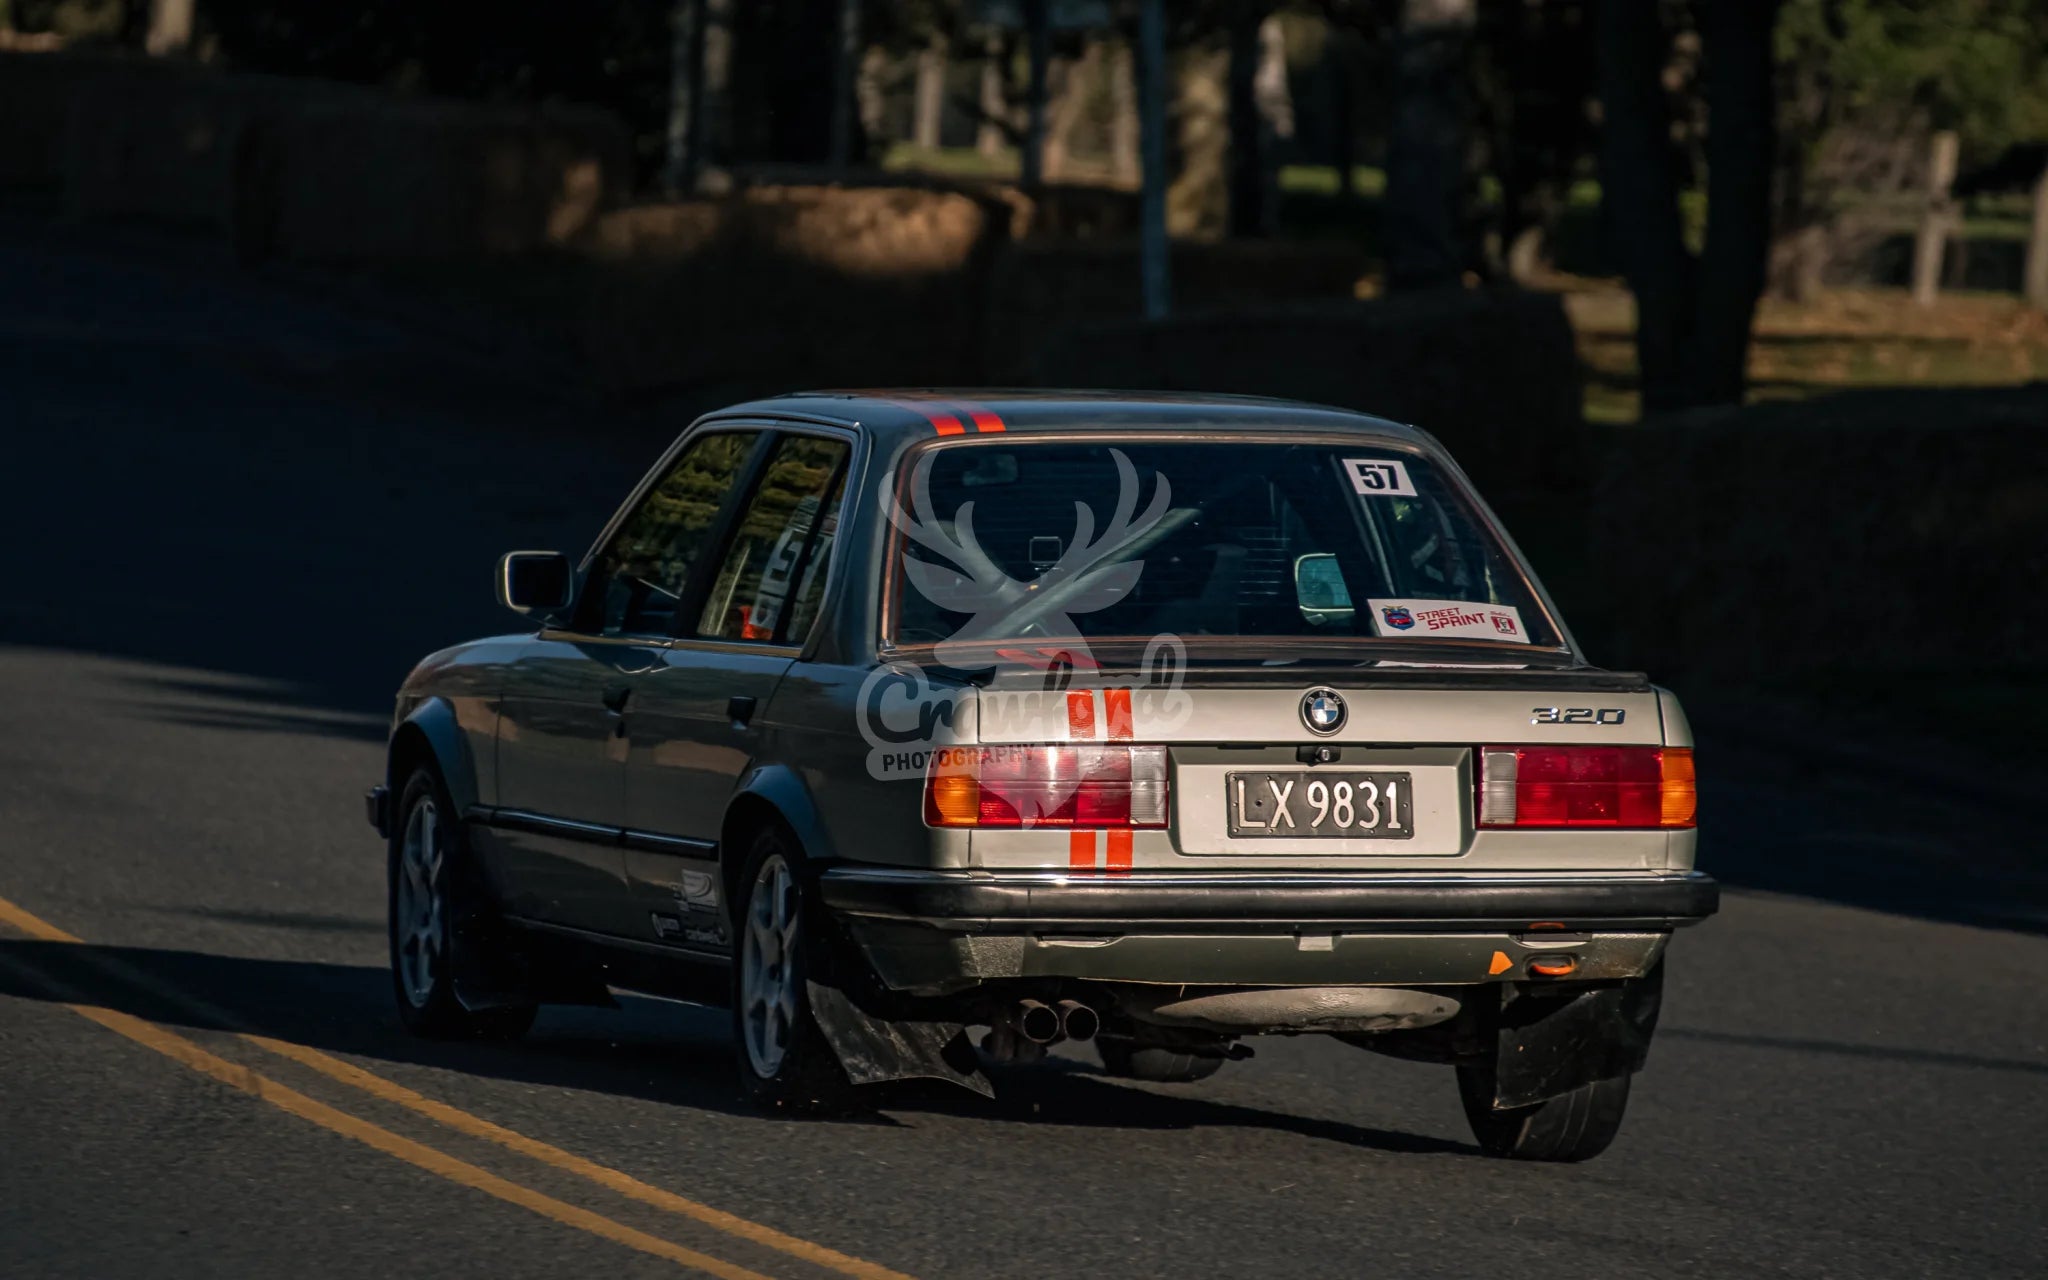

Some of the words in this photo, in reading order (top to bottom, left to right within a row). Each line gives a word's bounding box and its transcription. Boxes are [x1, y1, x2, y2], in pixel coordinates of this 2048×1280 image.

[1355, 463, 1400, 490] 57
[1416, 607, 1461, 621] STREET
[1426, 612, 1487, 630] SPRINT
[1531, 707, 1626, 725] 320
[1237, 780, 1296, 828] LX
[1307, 780, 1402, 828] 9831
